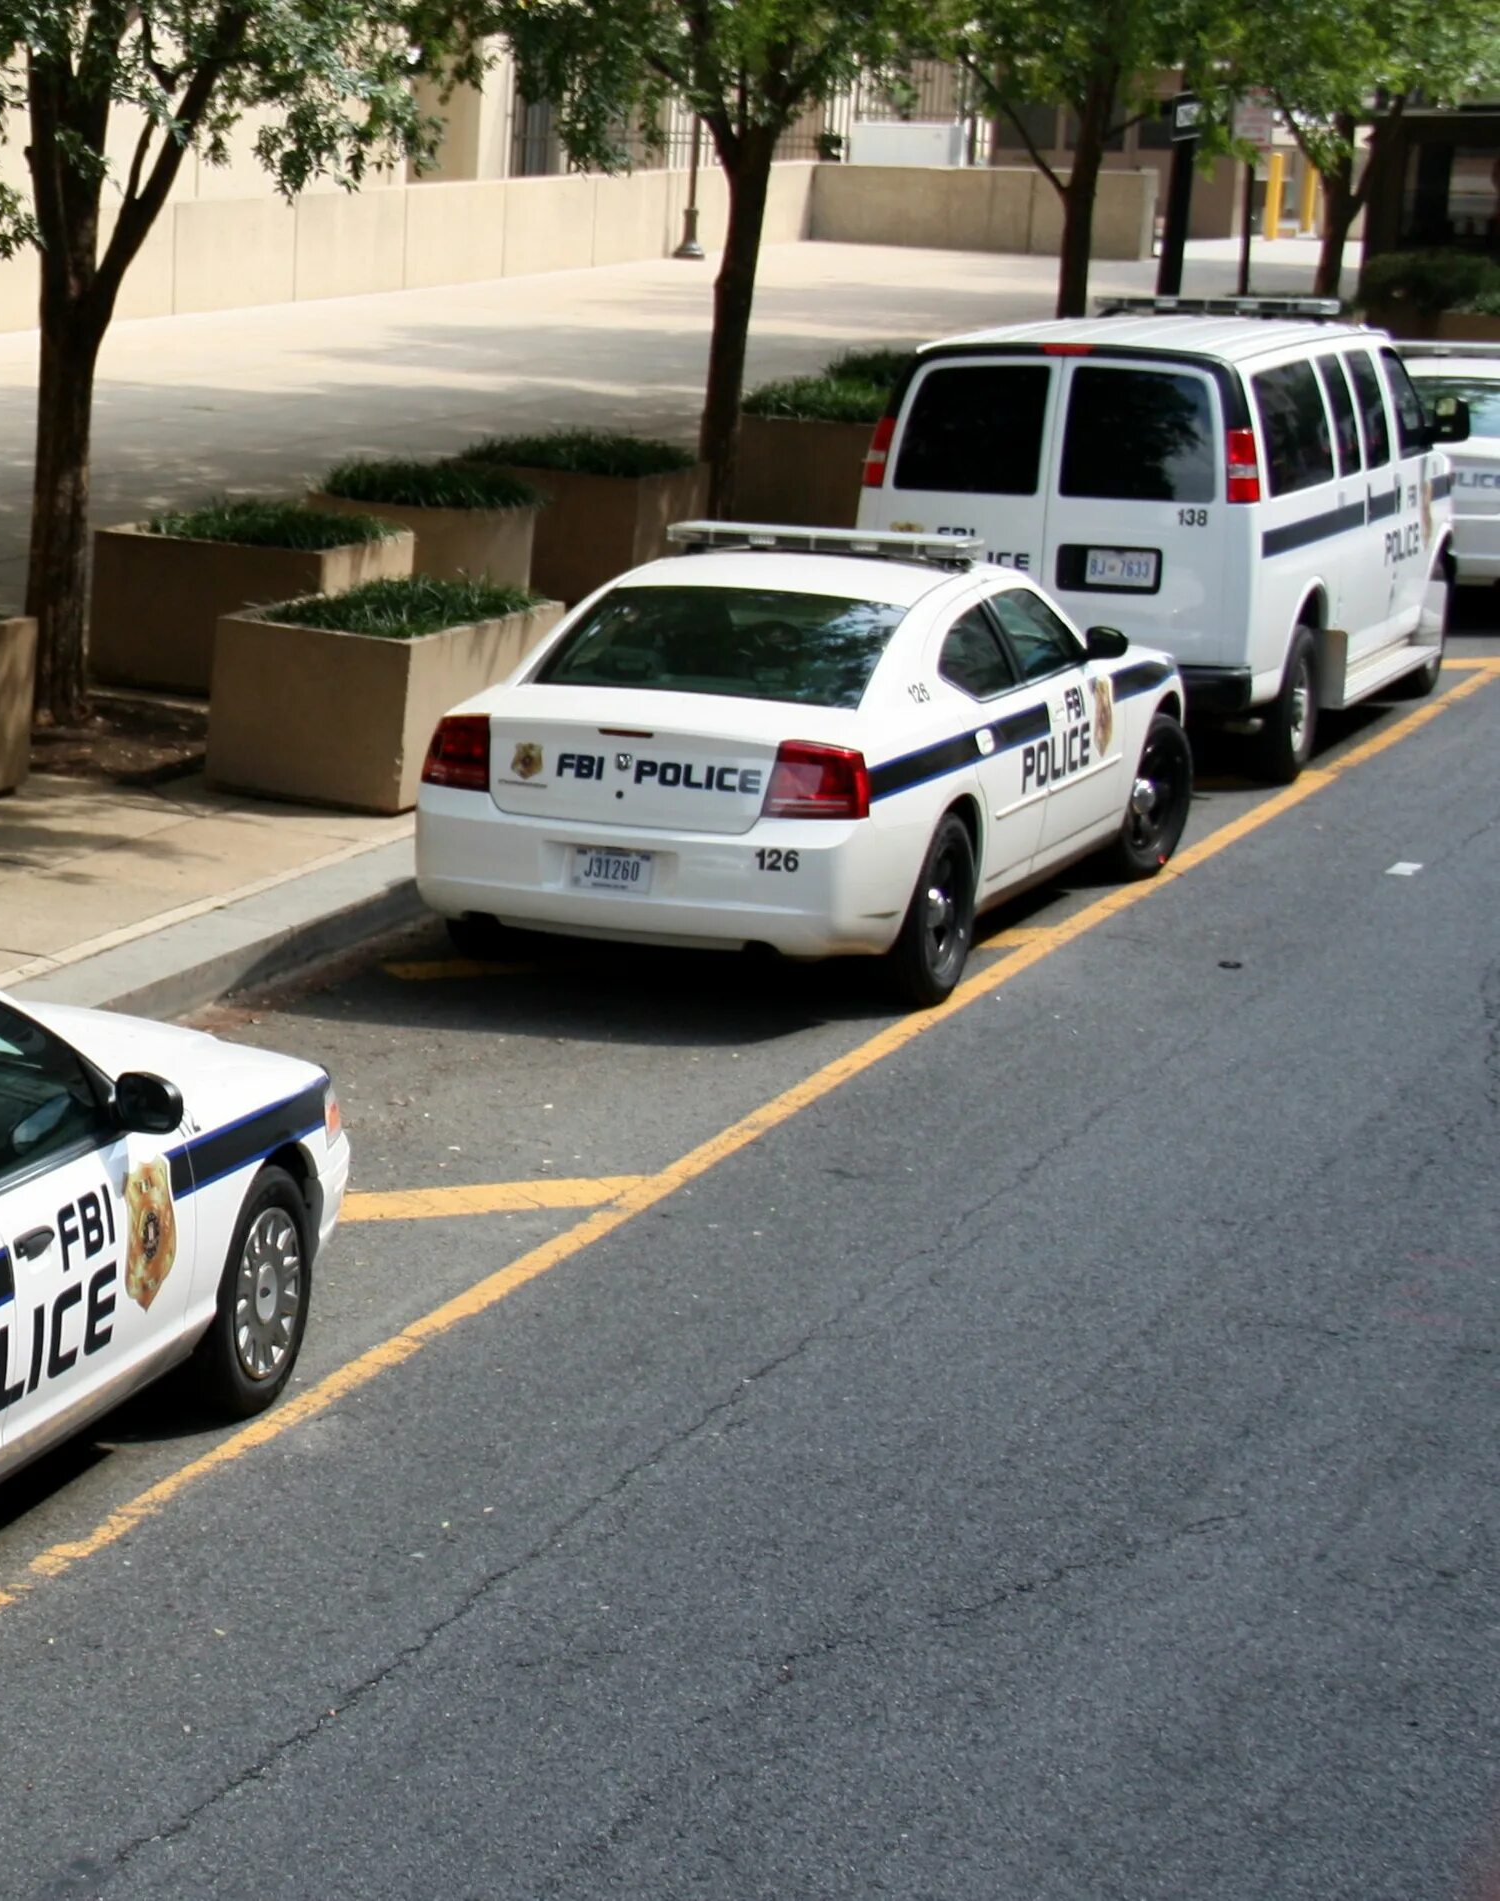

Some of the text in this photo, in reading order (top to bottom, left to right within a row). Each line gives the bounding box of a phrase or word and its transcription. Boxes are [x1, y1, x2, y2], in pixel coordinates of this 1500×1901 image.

[1178, 508, 1207, 527] 138
[1384, 522, 1419, 567] POLICE
[987, 551, 1030, 571] ICE
[907, 682, 931, 704] 126
[1064, 685, 1086, 722] FBI
[556, 753, 762, 794] FBI POLICE
[1021, 721, 1091, 795] POLICE
[583, 857, 641, 882] J31260
[755, 848, 800, 873] 126
[56, 1184, 117, 1273] FBI
